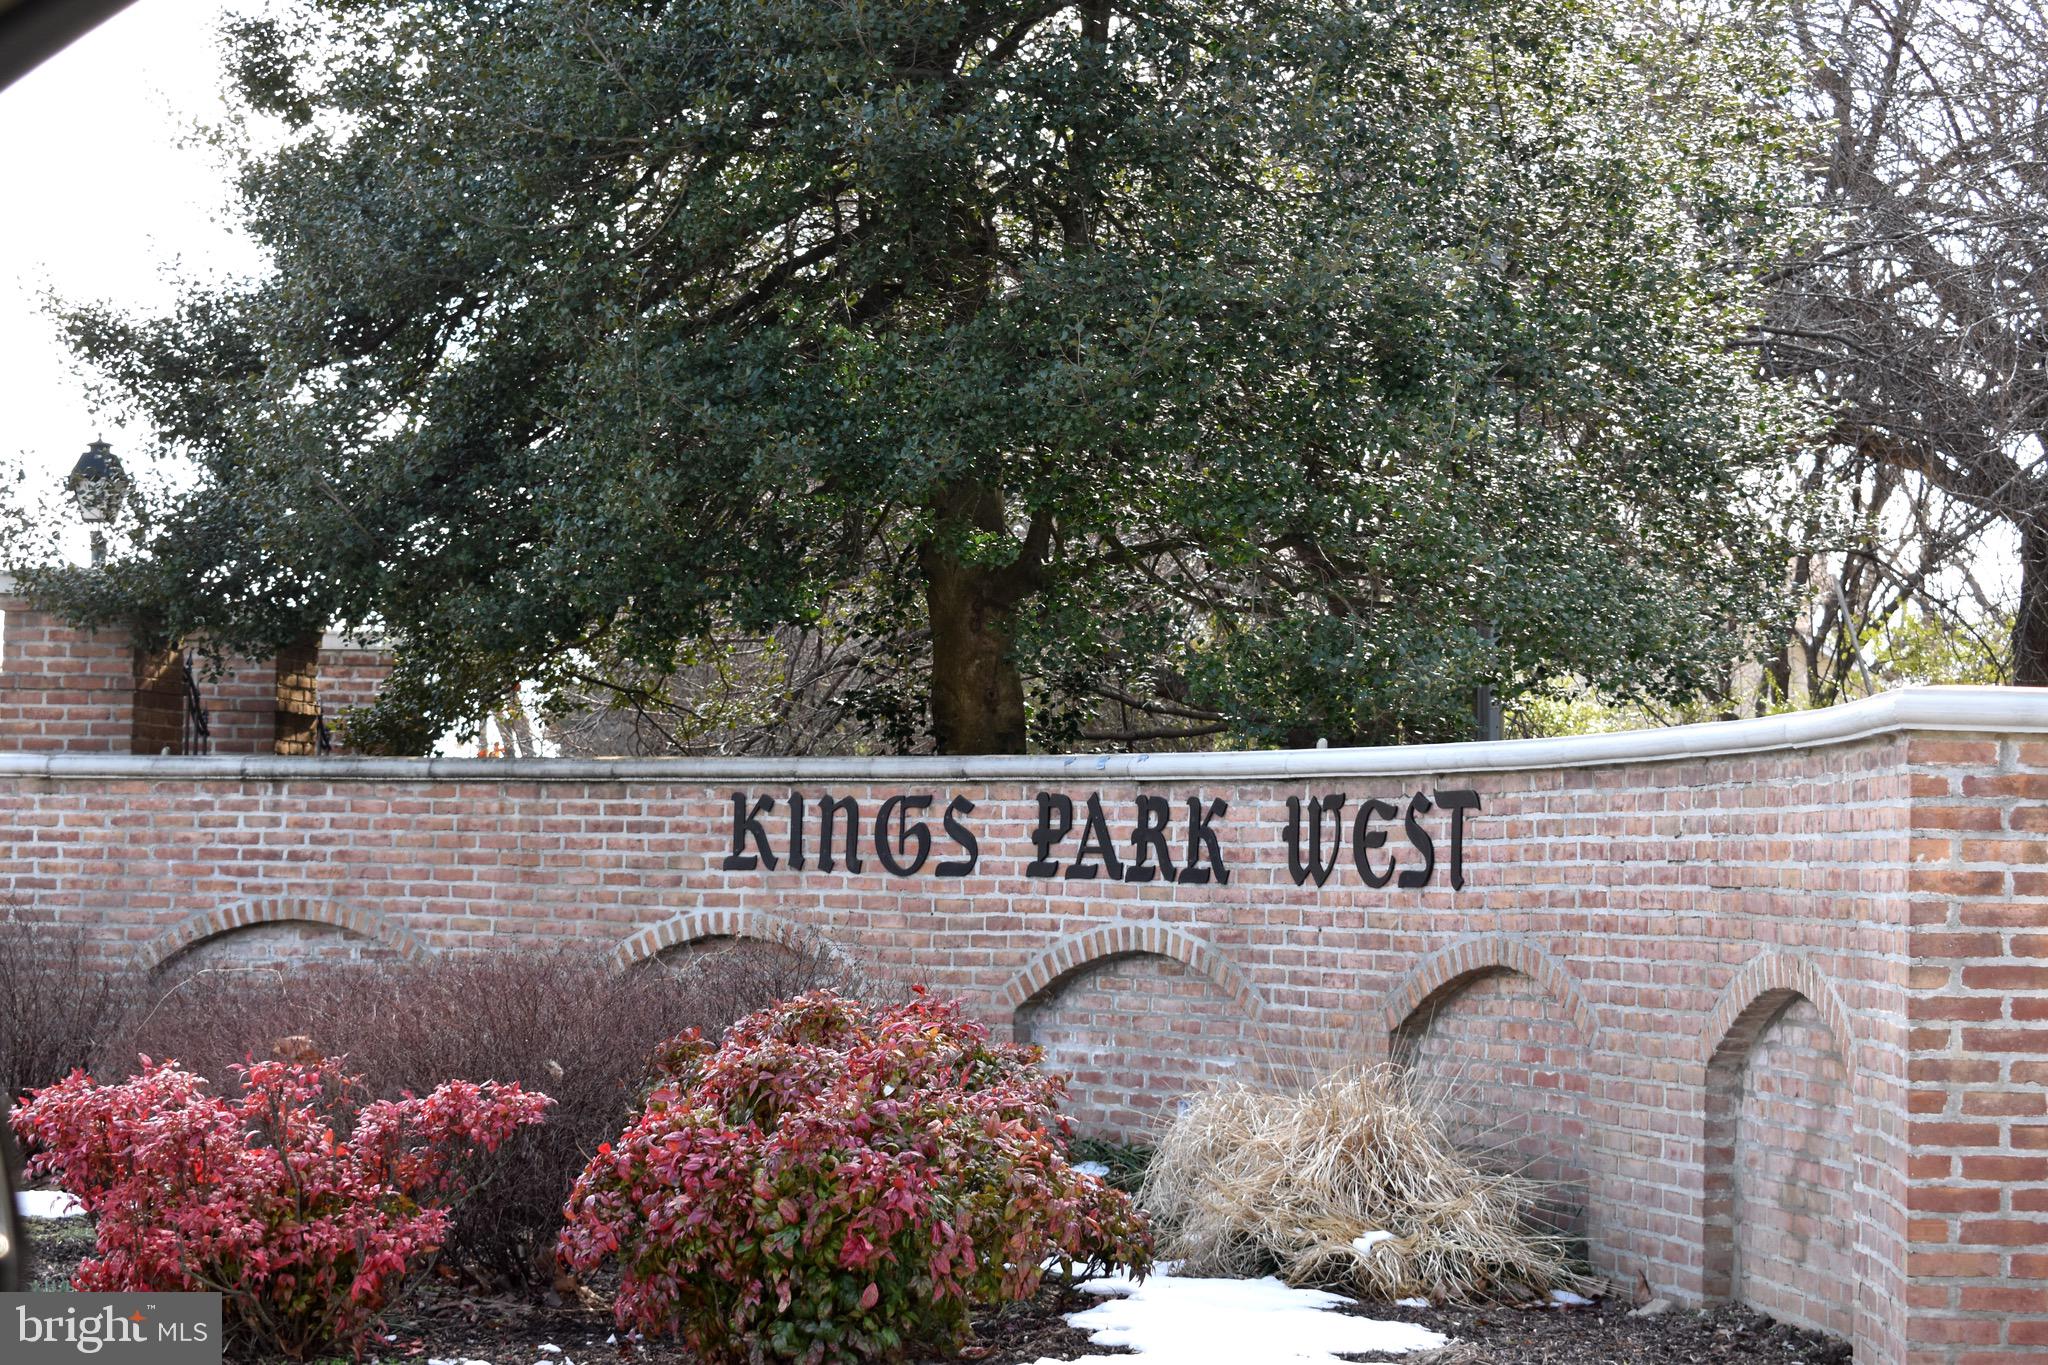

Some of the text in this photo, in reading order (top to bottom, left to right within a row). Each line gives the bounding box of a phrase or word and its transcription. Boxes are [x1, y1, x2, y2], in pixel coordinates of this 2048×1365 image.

[723, 789, 1482, 891] KINGS PARK WEST
